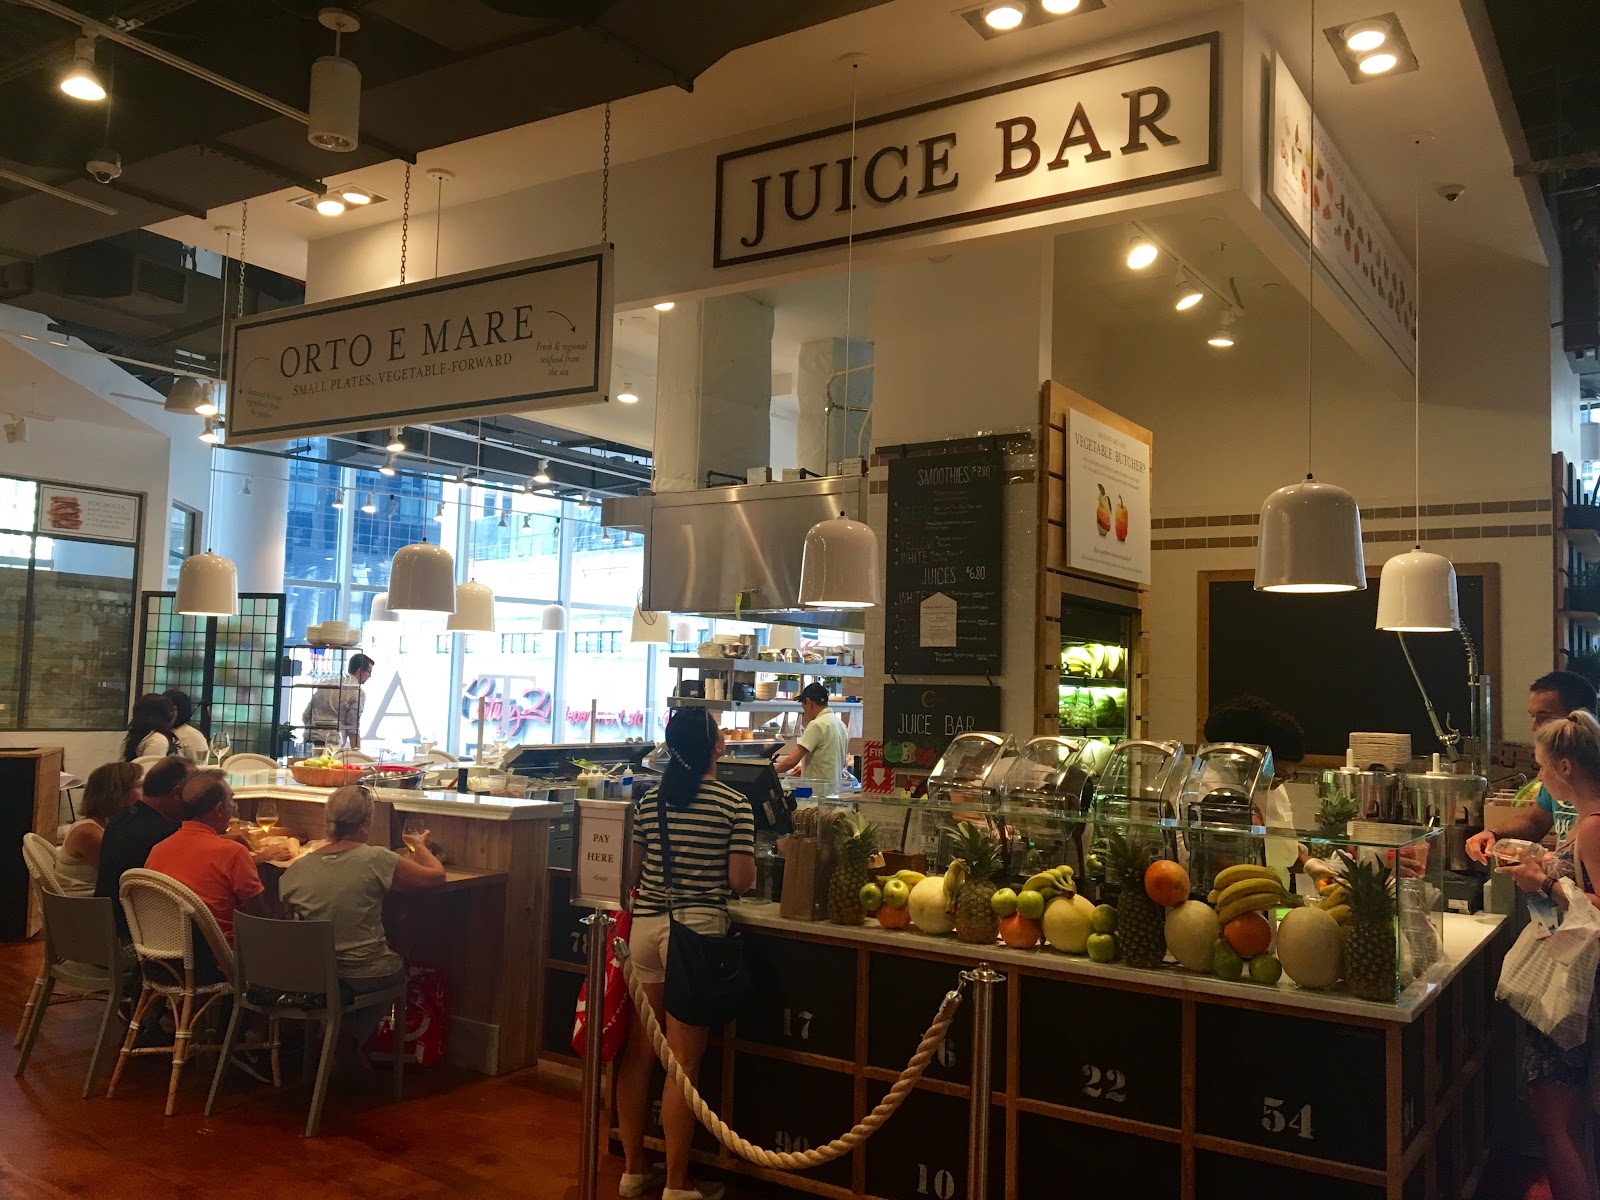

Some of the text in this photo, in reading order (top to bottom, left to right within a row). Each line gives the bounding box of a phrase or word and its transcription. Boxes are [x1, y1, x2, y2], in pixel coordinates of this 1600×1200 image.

[740, 132, 959, 248] JUICE
[995, 86, 1180, 183] BAR
[280, 304, 534, 378] ORTO E MARE
[536, 341, 553, 351] Fresh
[292, 352, 513, 397] SMALL PLATES, VEGETABLE-FORWARD
[1074, 432, 1113, 460] VEGETABLE
[917, 465, 970, 486] SMOOTHIES
[921, 566, 957, 585] JUICES
[897, 712, 975, 737] JUICE BAR
[869, 747, 884, 758] FIR
[593, 833, 611, 843] PAY
[587, 852, 614, 863] HERE
[783, 1007, 814, 1040] 17
[1081, 1064, 1127, 1103] 22
[1261, 1096, 1315, 1140] 54
[916, 1163, 956, 1199] 10
